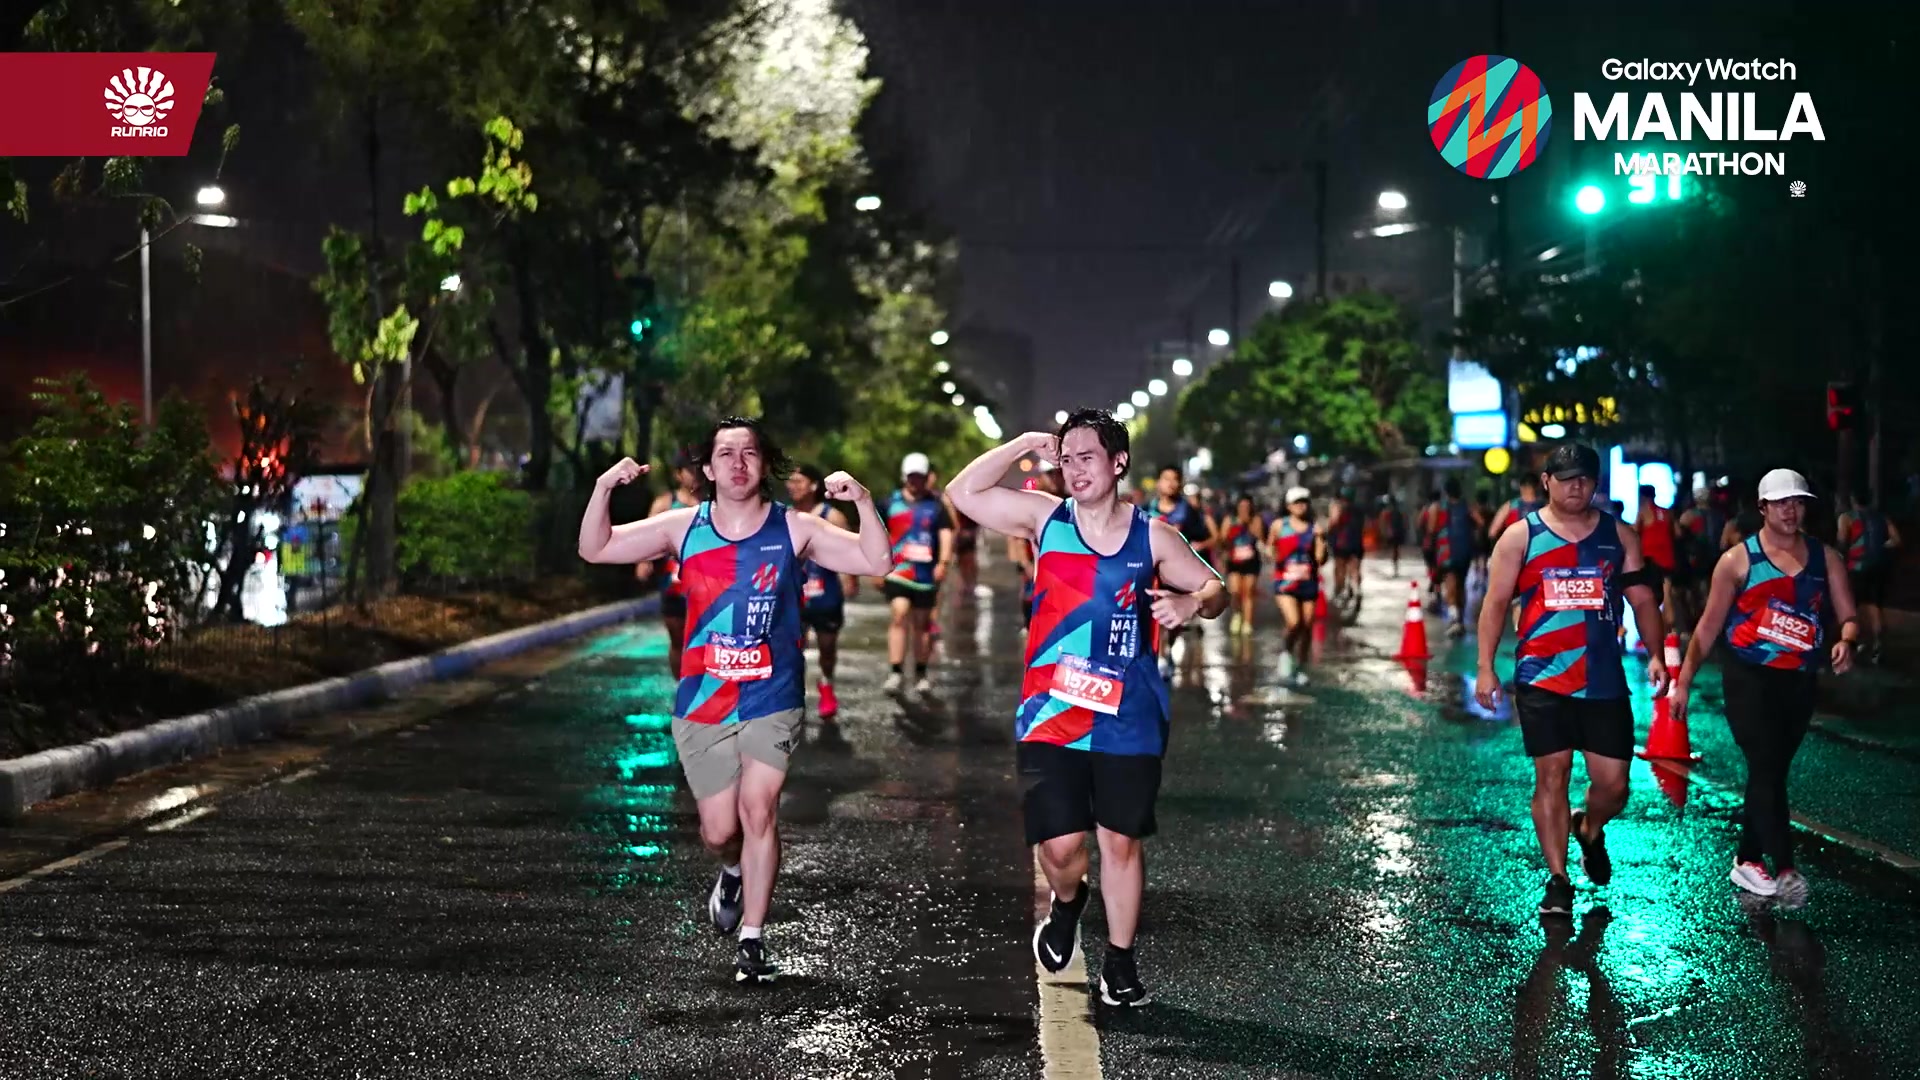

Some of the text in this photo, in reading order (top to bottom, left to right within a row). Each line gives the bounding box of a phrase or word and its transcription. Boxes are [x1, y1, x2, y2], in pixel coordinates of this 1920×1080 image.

[1552, 580, 1595, 593] 14523
[1771, 612, 1810, 638] 14522
[714, 647, 762, 665] 15780
[1063, 669, 1113, 697] 15779
